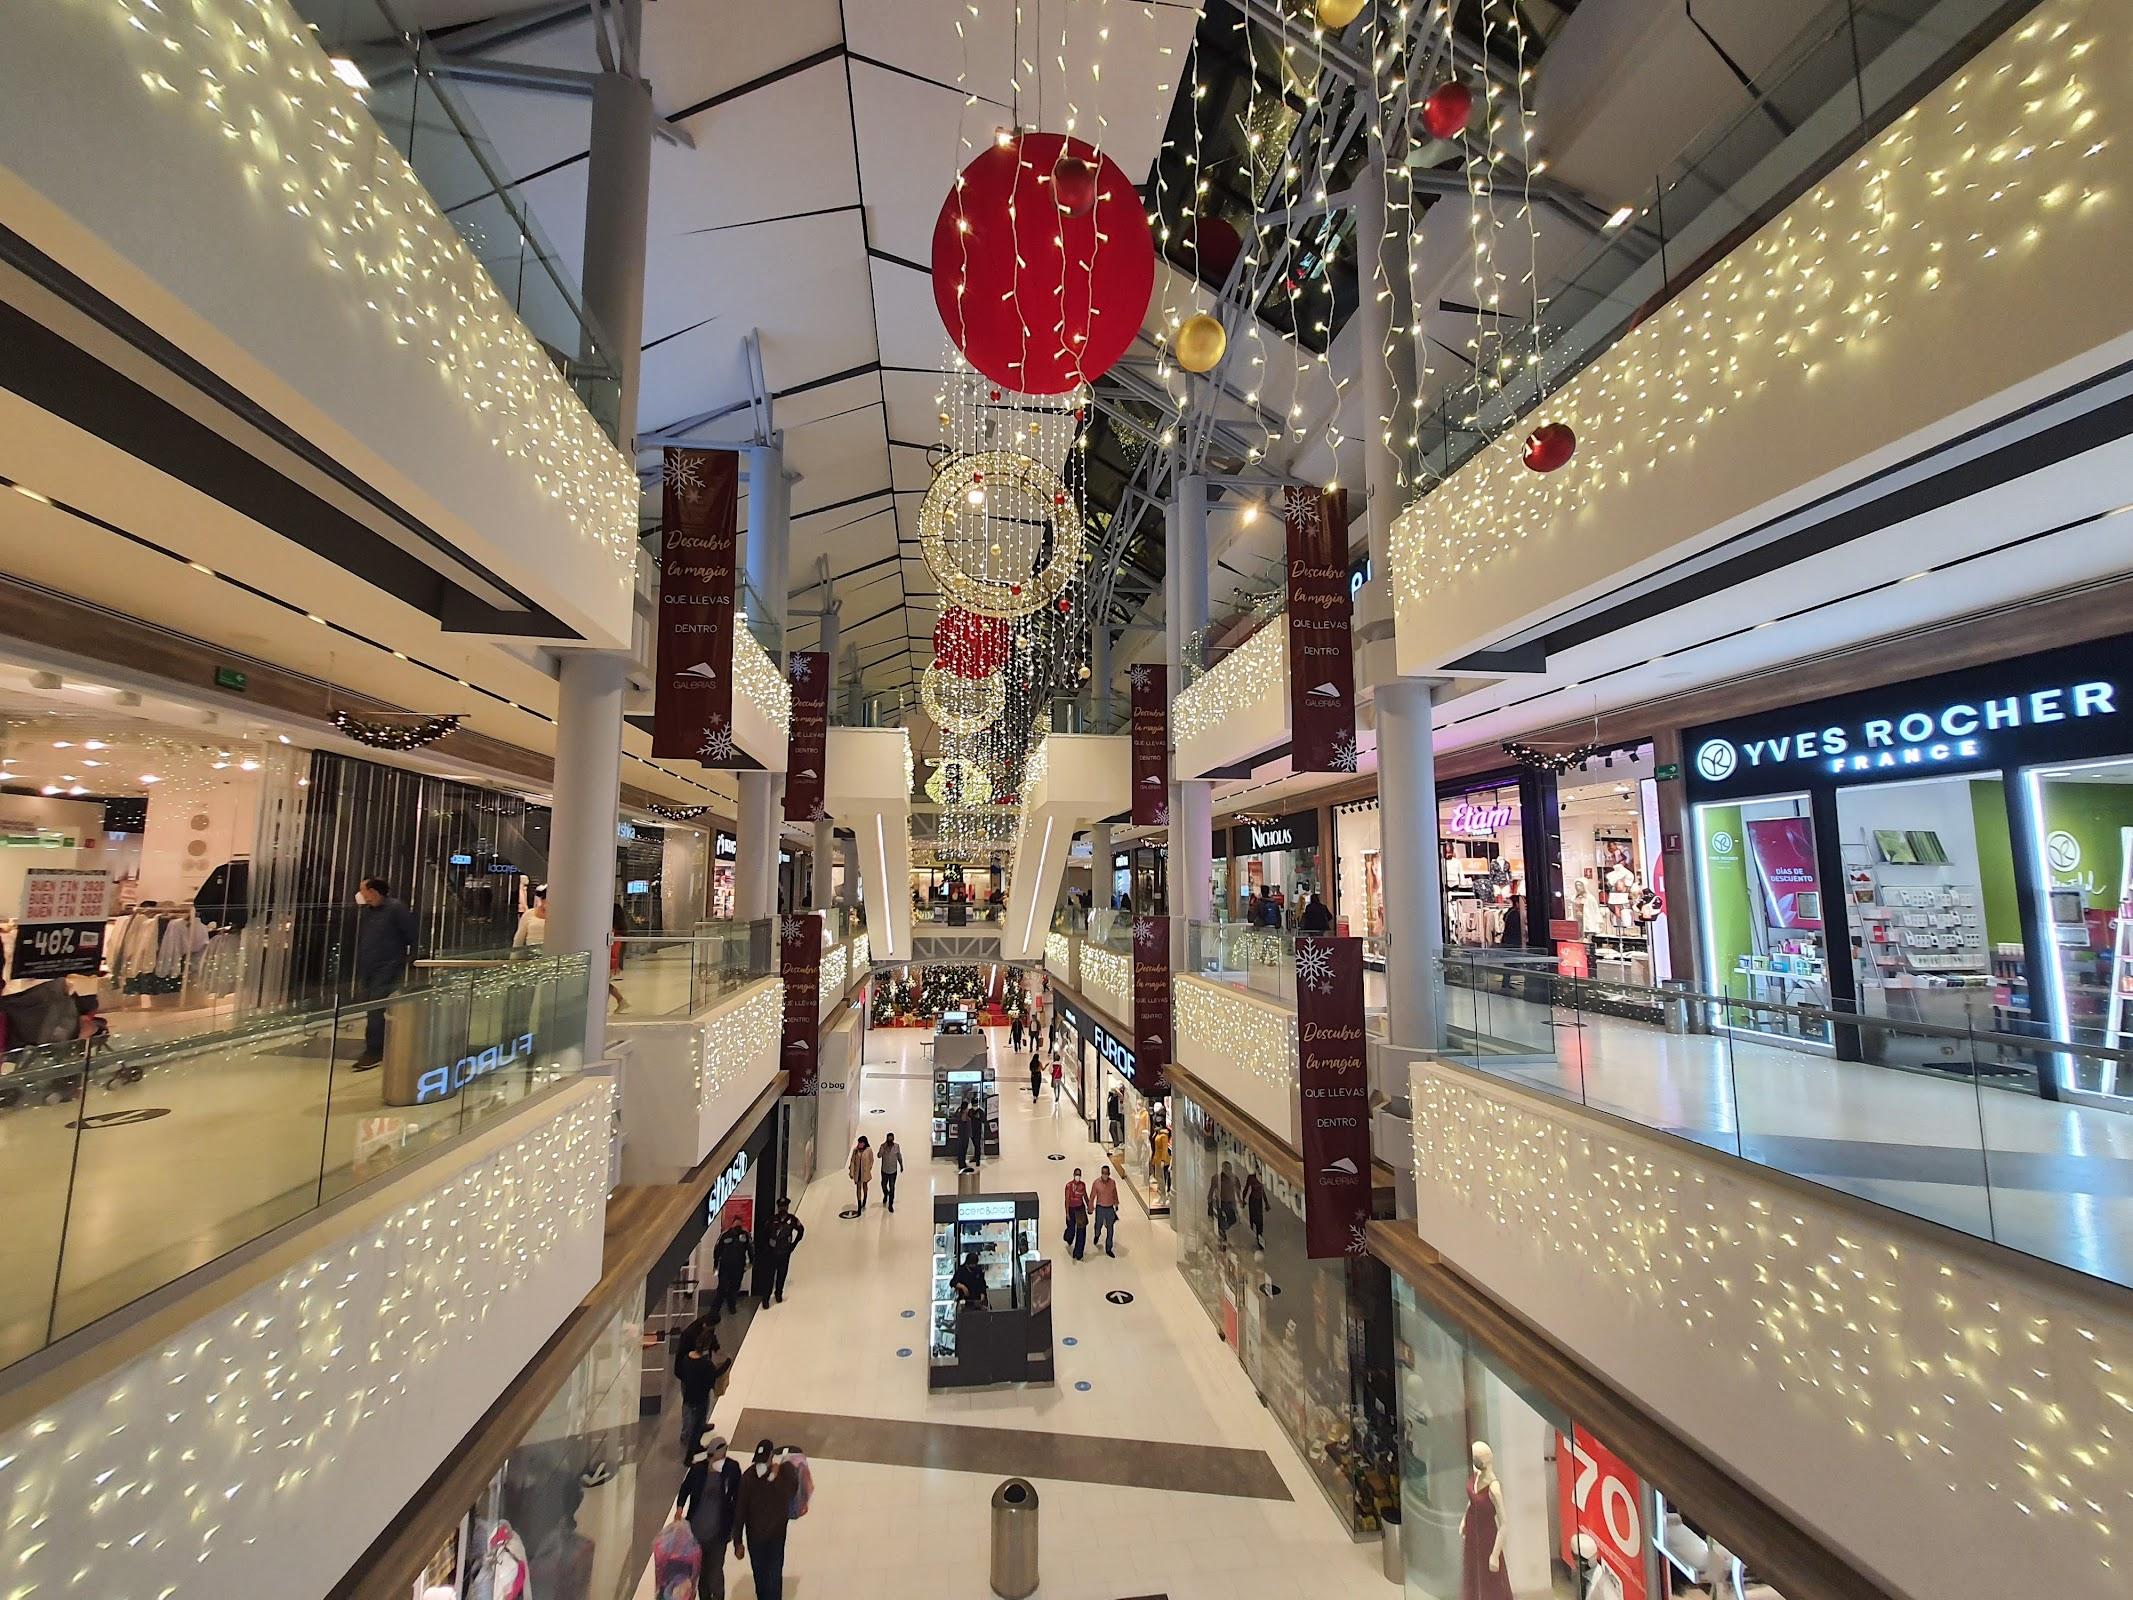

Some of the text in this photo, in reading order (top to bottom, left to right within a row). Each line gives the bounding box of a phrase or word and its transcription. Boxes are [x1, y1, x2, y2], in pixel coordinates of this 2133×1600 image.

[667, 530, 731, 550] Descubre
[668, 561, 728, 583] la magia
[1292, 560, 1345, 579] Descubre
[664, 595, 730, 605] QUE LLEVAS
[1294, 587, 1345, 609] la magia
[675, 624, 718, 633] DENTRO
[1293, 620, 1348, 630] QUE LLEVAS
[1304, 646, 1339, 656] DENTRO
[1744, 682, 2117, 766] YVES ROCHER
[1831, 740, 1980, 773] FRANCE
[1451, 803, 1512, 833] Etam
[1251, 825, 1292, 850] NICHOLAS
[60, 880, 78, 892] FIN
[59, 893, 76, 905] FIN
[57, 905, 75, 918] FIN
[23, 927, 76, 956] -40%
[1304, 1021, 1361, 1042] Descubre
[1306, 1053, 1361, 1075] la magia
[828, 1081, 845, 1090] bag
[1305, 1087, 1365, 1098] QUE LLEVAS
[1317, 1118, 1357, 1128] DENTRO
[1563, 1437, 1641, 1558] 70
